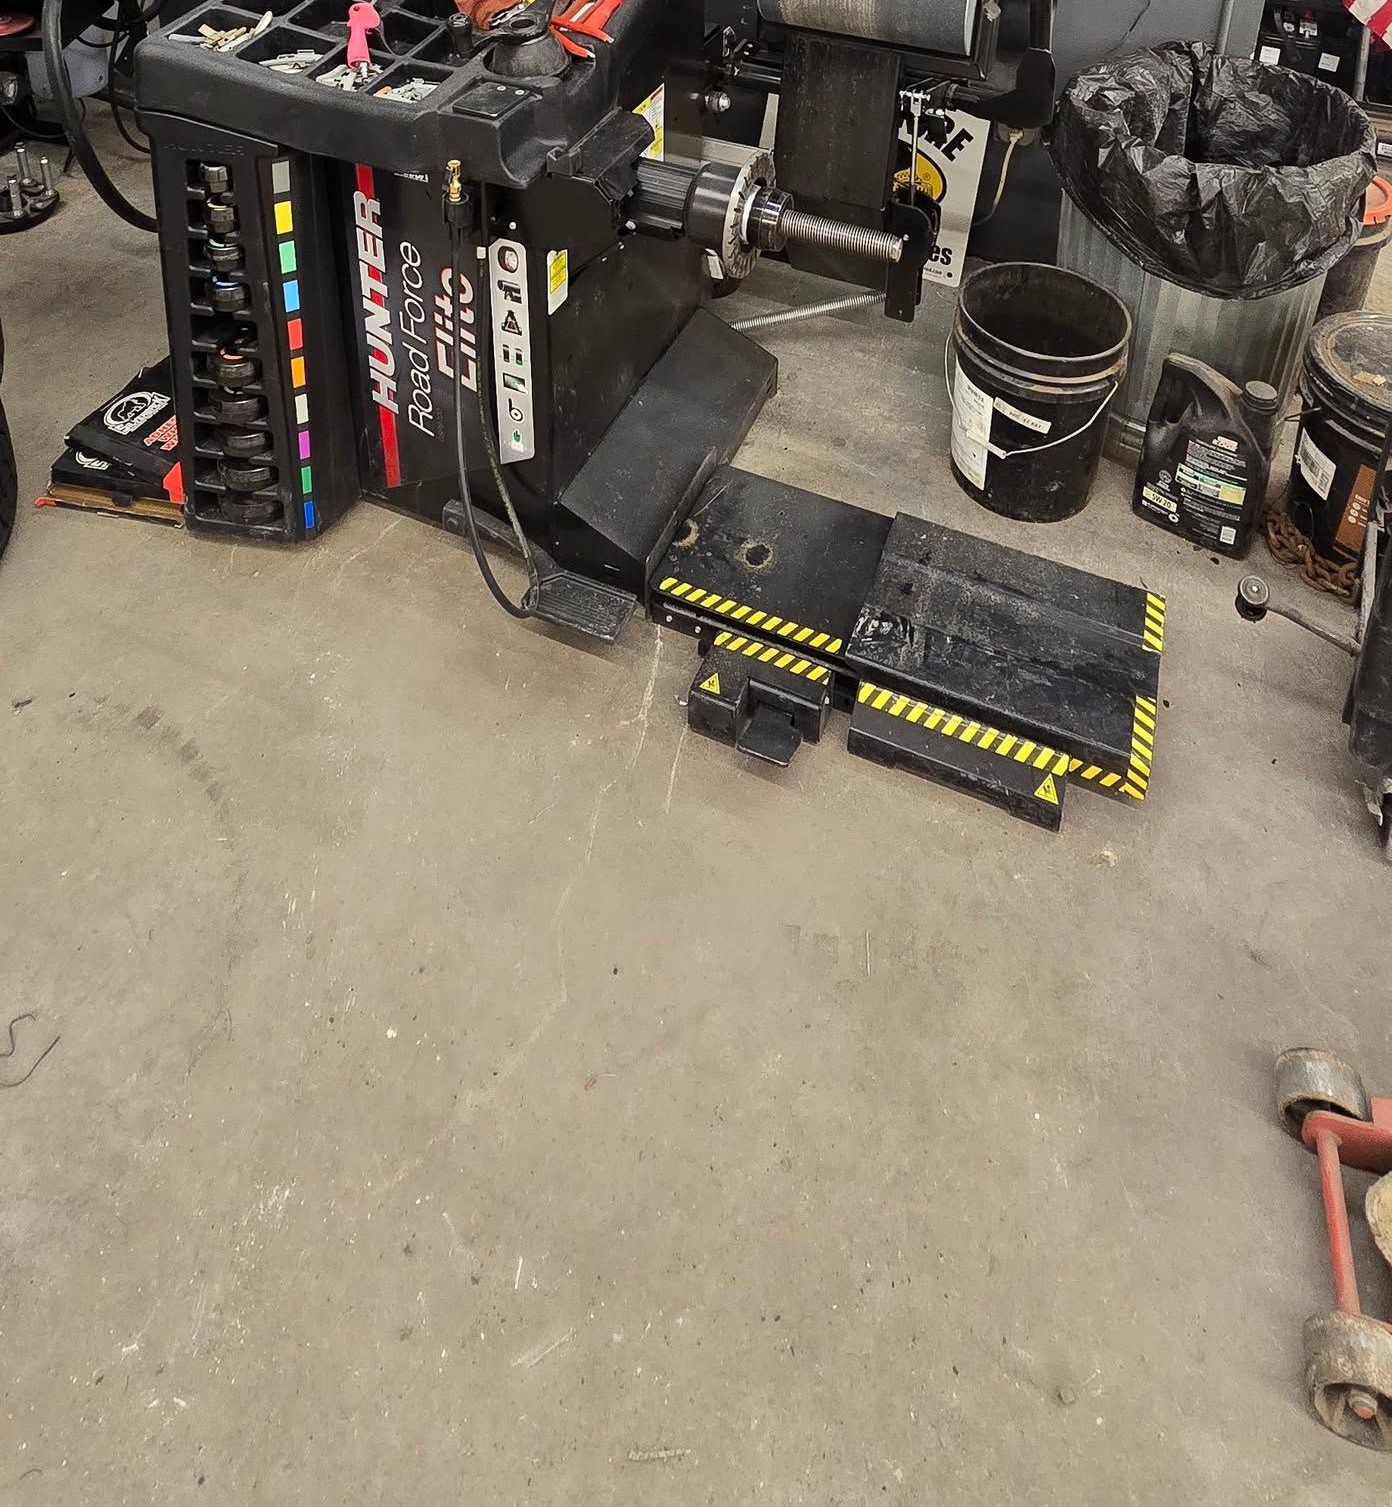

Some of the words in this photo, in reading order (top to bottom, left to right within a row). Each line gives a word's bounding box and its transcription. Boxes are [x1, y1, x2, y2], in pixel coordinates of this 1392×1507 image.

[353, 190, 400, 415] HUNTER
[399, 240, 428, 344] Force
[433, 267, 479, 393] Elite
[402, 341, 436, 438] Road
